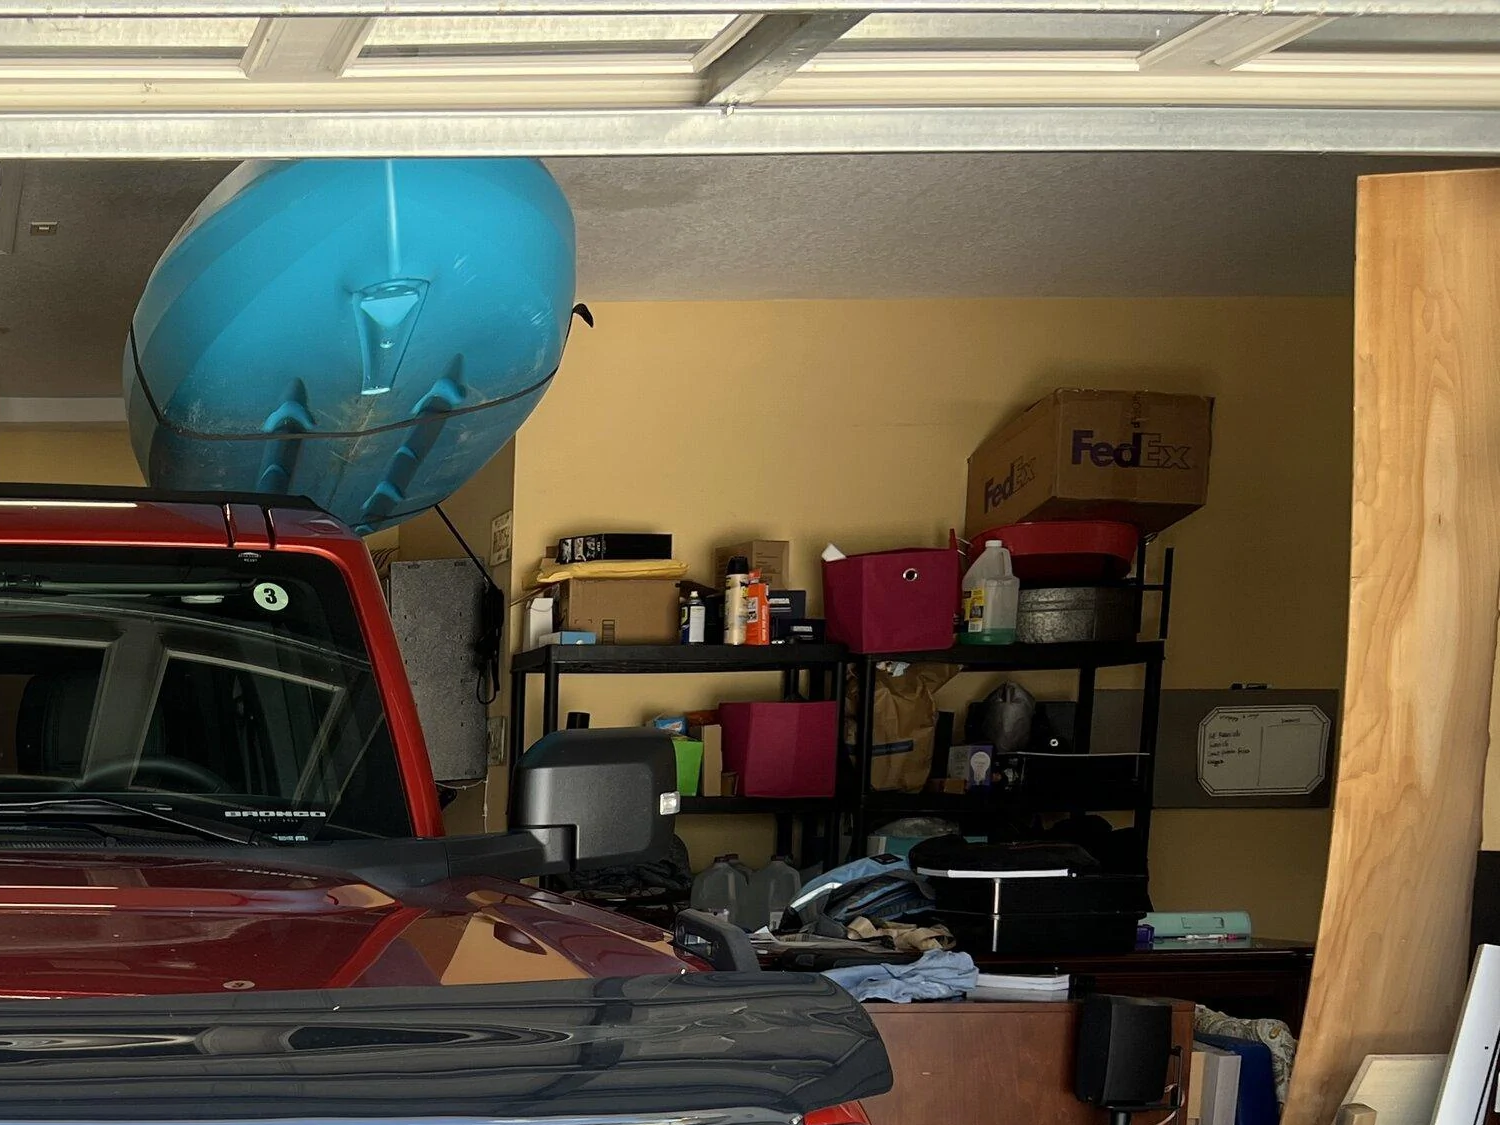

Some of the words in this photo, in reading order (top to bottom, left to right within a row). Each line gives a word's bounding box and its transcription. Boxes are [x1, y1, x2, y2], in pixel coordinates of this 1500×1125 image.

[1071, 430, 1191, 469] FedEx
[984, 456, 1037, 514] FedEx
[263, 588, 277, 604] 3
